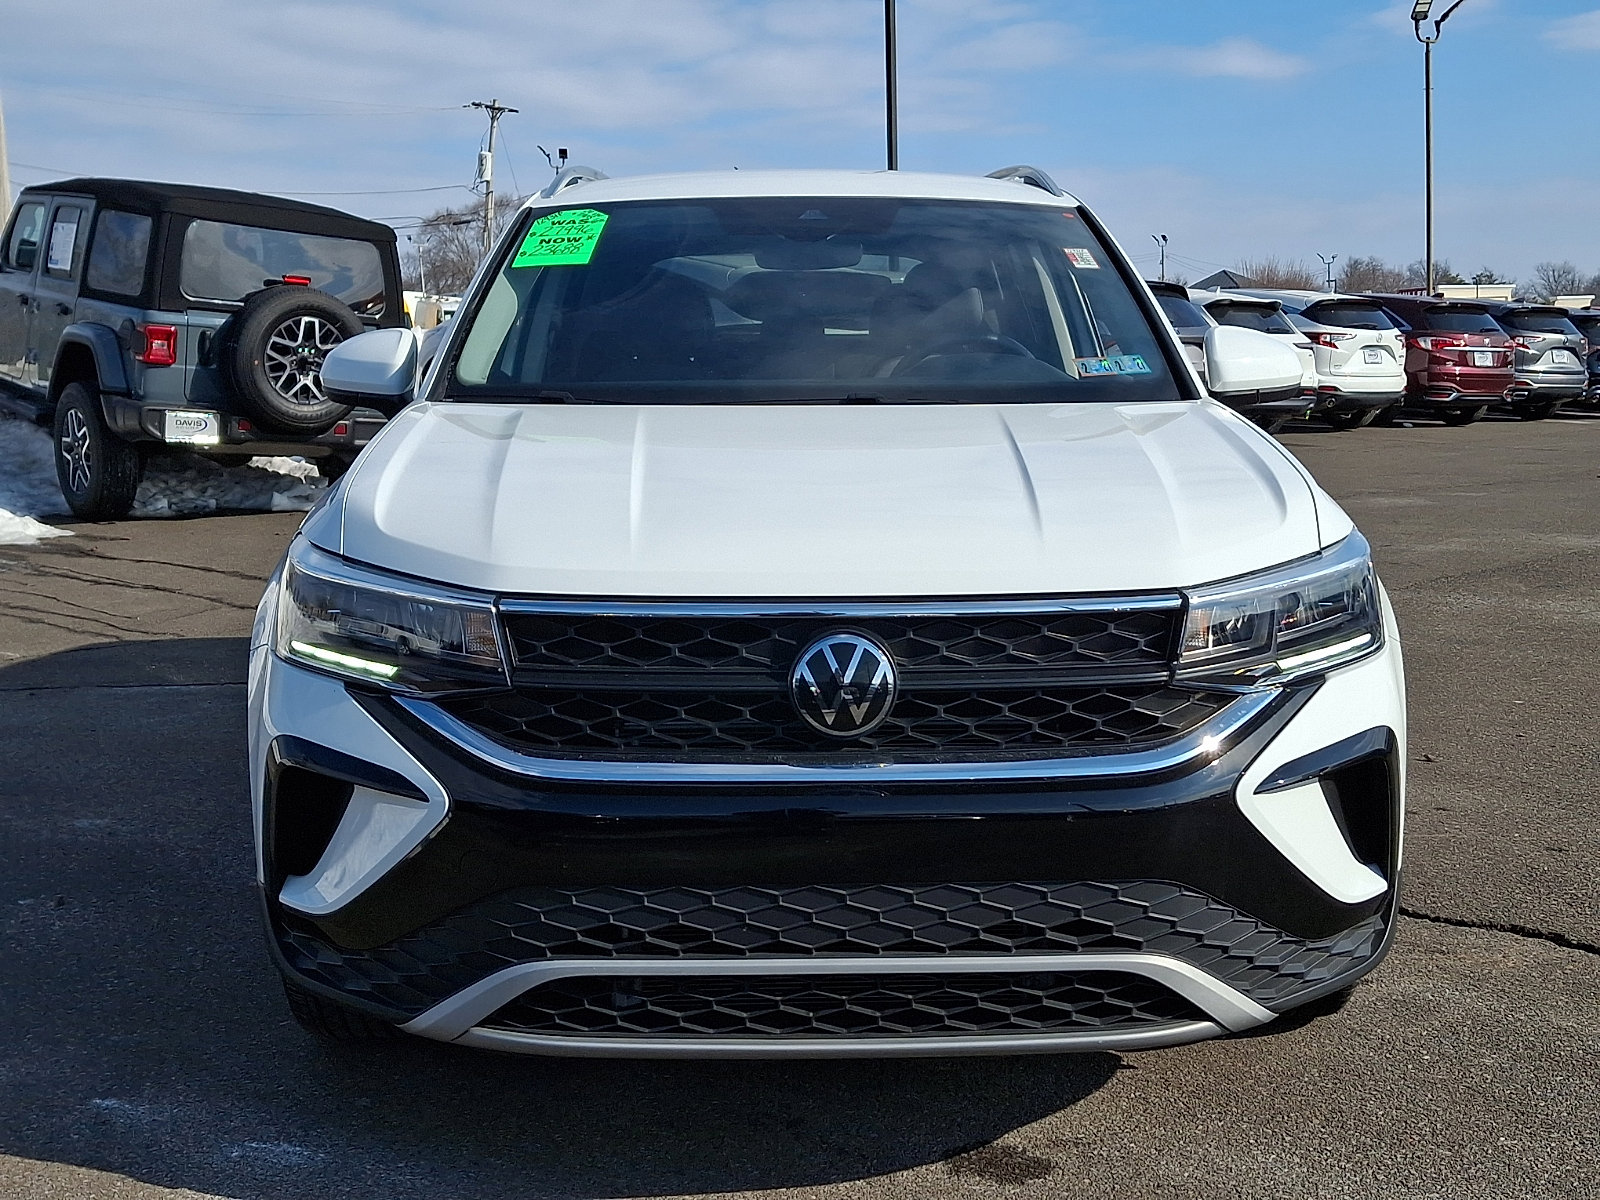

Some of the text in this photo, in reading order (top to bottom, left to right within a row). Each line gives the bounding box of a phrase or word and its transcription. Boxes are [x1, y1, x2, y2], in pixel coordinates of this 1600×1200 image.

[550, 218, 589, 226] WAS
[539, 236, 583, 245] NOW
[175, 419, 203, 427] DAVIS
